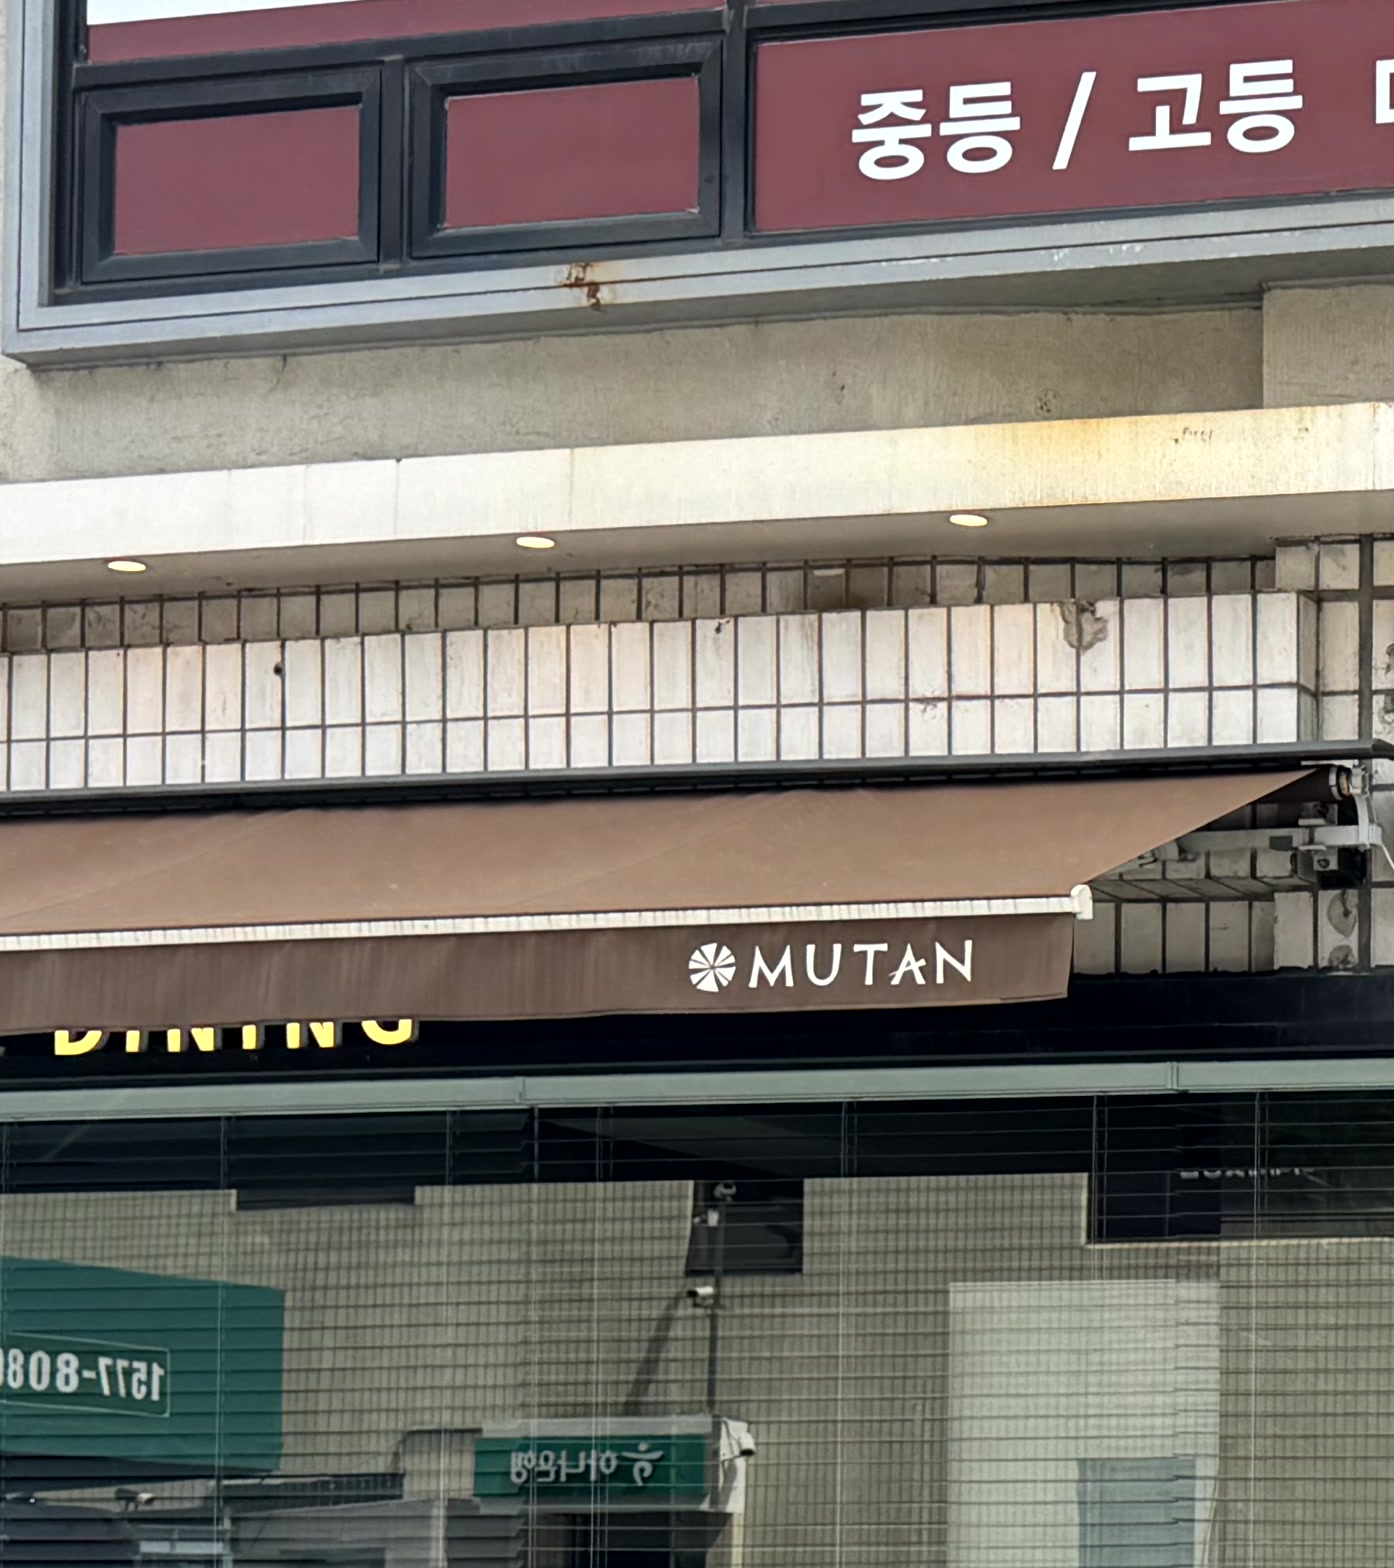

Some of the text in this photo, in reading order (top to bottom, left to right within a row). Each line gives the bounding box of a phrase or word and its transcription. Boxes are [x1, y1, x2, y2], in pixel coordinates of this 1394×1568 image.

[851, 82, 1022, 181] 중등
[1052, 71, 1097, 170] /
[1128, 60, 1303, 154] 고등
[747, 940, 973, 988] MUTAN
